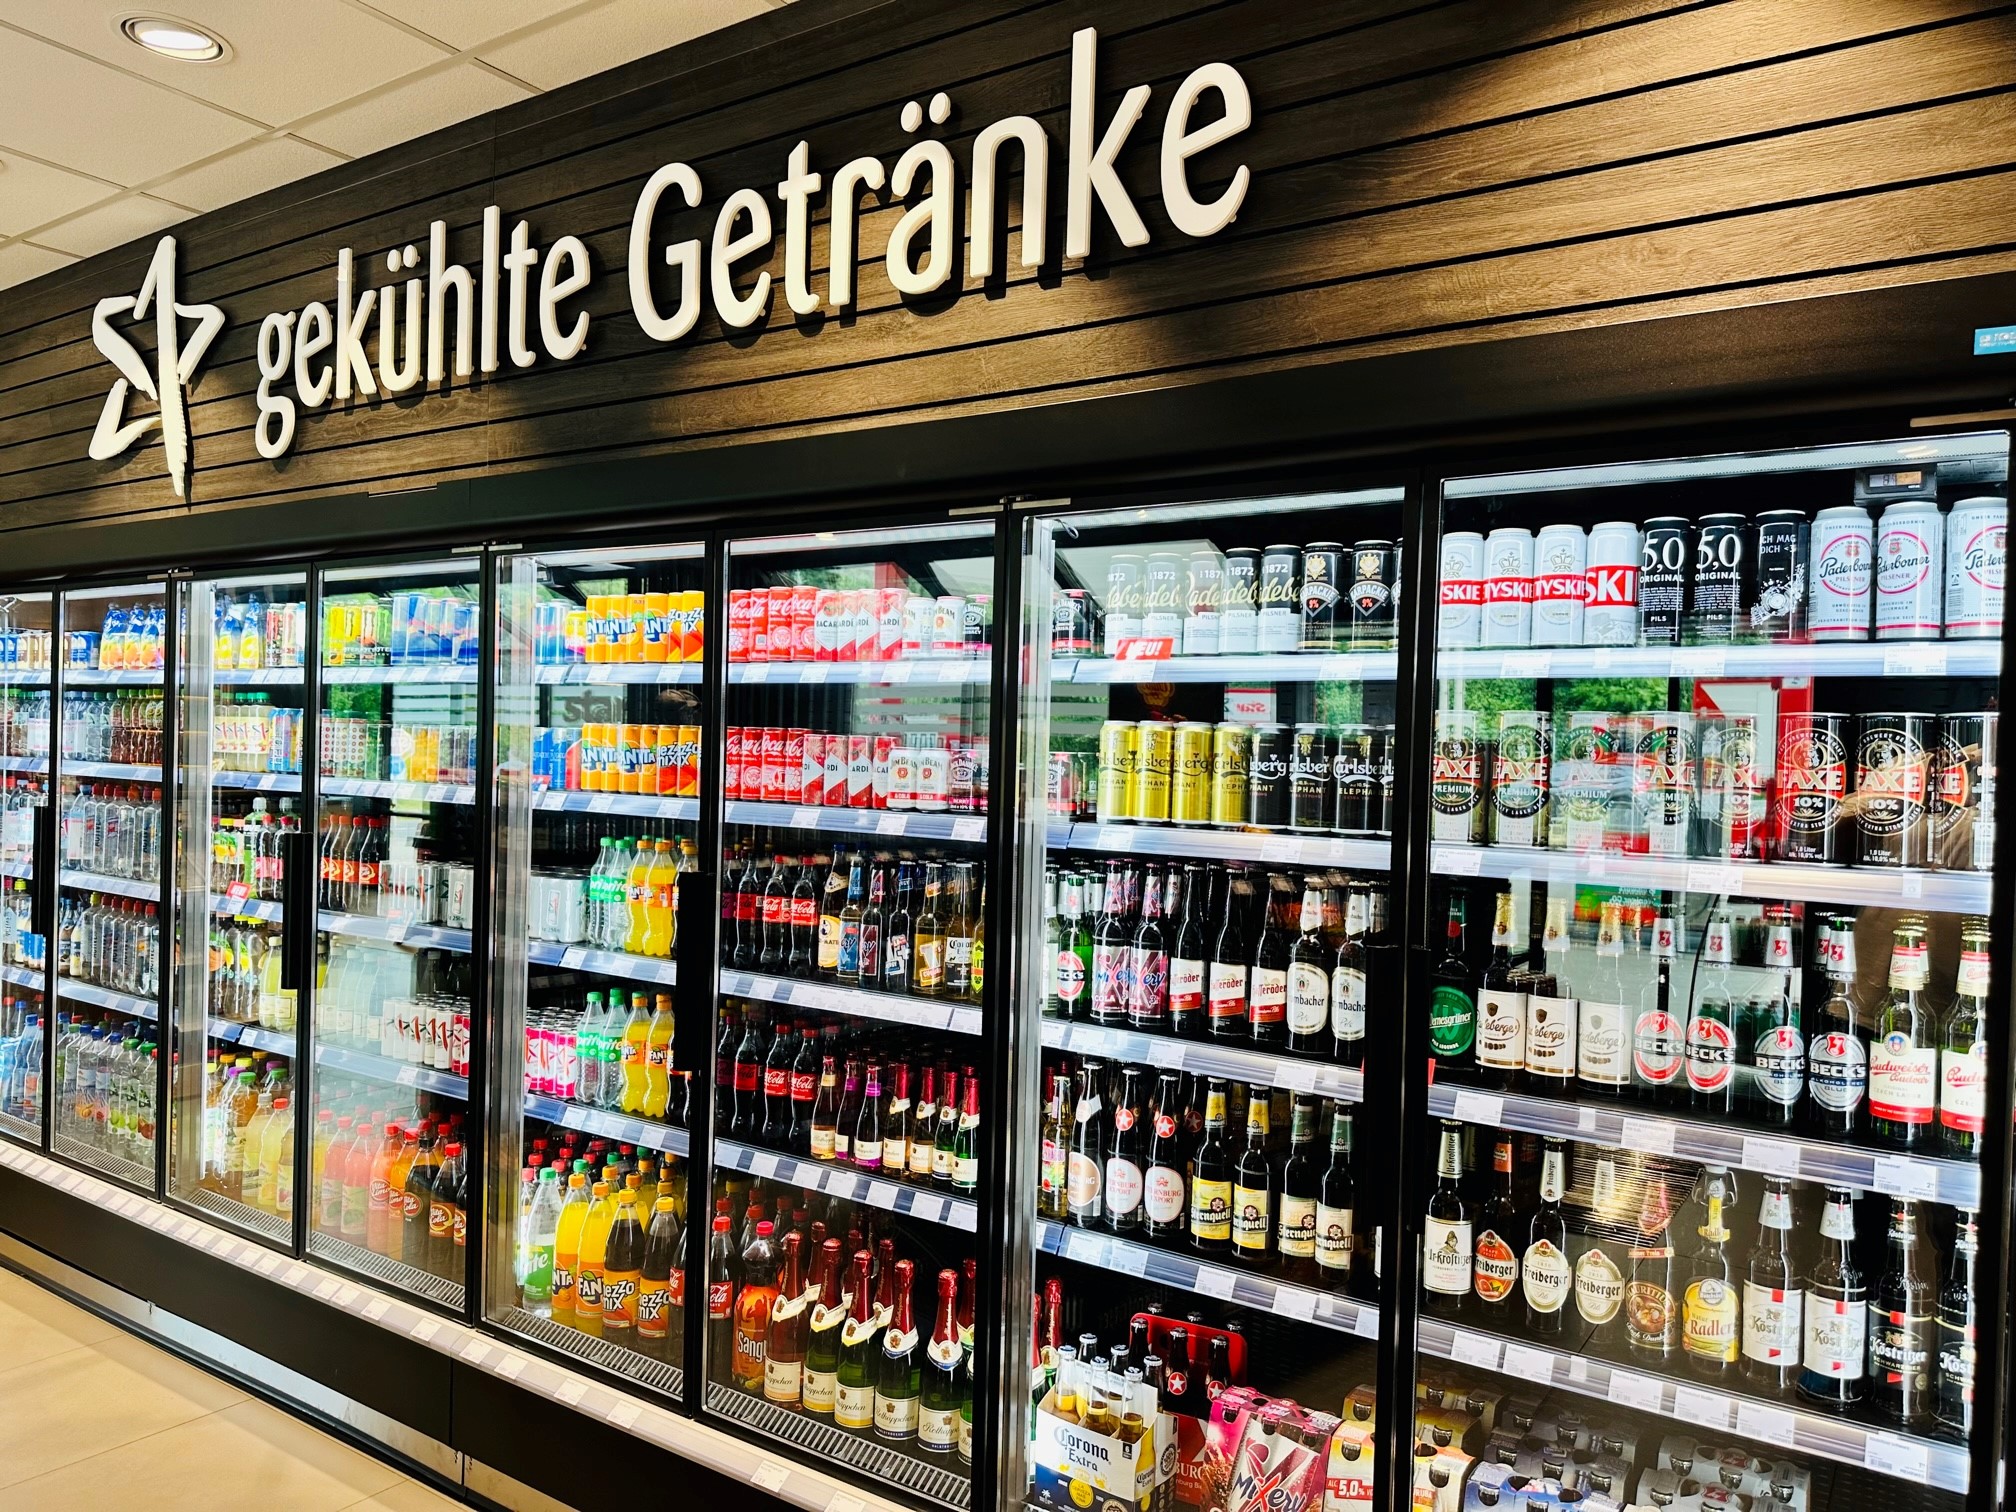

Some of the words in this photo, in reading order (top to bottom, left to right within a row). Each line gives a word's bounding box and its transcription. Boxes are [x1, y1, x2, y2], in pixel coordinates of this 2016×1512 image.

[256, 205, 590, 459] gekühlte
[628, 27, 1252, 342] Getränke
[1776, 534, 1796, 544] MAG
[1641, 537, 1684, 572] 5,0
[1697, 534, 1741, 569] 5,0
[1153, 571, 1176, 580] 1872
[1230, 566, 1254, 576] 1872
[1265, 564, 1288, 574] 1872
[1695, 571, 1741, 581] ORIGINAL
[1640, 574, 1684, 583] ORIGINAL
[1440, 584, 1481, 601] SKIE
[1493, 762, 1548, 780] FAXE
[1642, 765, 1696, 785] FAXE
[1777, 770, 1843, 791] FAXE
[1855, 771, 1920, 792] FAXE
[1433, 784, 1473, 794] PREMIUM
[1500, 788, 1539, 797] PREMIUM
[1565, 789, 1608, 798] PREMIUM
[1648, 792, 1689, 801] PREMIUM
[1793, 796, 1824, 807] 10%
[1867, 798, 1898, 810] 10%
[1635, 1039, 1684, 1054] BECK'S
[1686, 1043, 1734, 1062] BECK'S
[1756, 1057, 1805, 1070] BECK'S
[1810, 1063, 1866, 1078] BECK'S
[1524, 1264, 1568, 1287] Freiberger
[1577, 1276, 1620, 1298] Freiberger
[1690, 1319, 1733, 1336] Radler
[1054, 1425, 1110, 1461] Corona
[1068, 1448, 1098, 1472] Extra
[1328, 1479, 1338, 1488] ALC
[1338, 1479, 1359, 1497] 5,0
